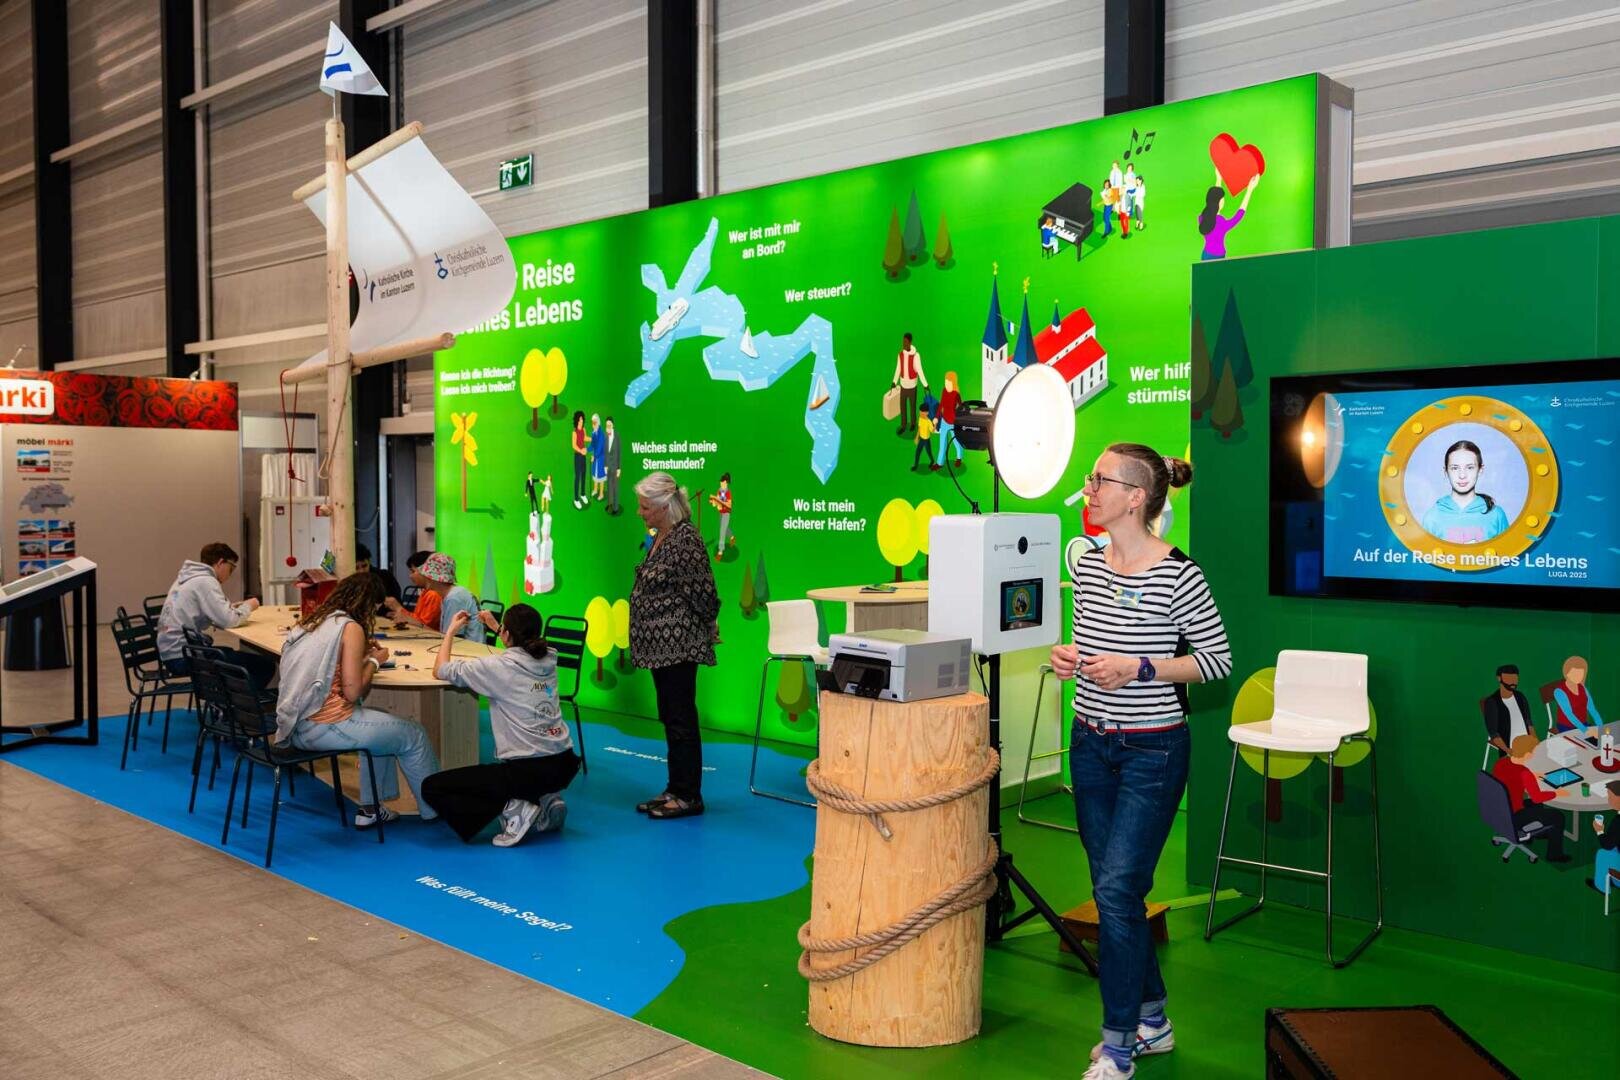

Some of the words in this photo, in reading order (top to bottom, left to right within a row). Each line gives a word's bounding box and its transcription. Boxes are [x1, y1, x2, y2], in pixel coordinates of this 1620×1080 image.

[728, 229, 747, 244] Wer
[749, 226, 762, 240] ist
[764, 223, 781, 237] mit
[783, 219, 801, 234] mir
[742, 250, 754, 259] an
[757, 240, 786, 257] Bord?
[522, 259, 575, 290] Reise
[784, 289, 805, 303] Wer
[807, 281, 852, 300] steuert?
[515, 297, 583, 328] Lebens
[460, 369, 471, 380] ich
[1129, 366, 1160, 381] Wer
[460, 384, 471, 394] ich
[471, 382, 487, 394] mich
[631, 441, 667, 454] Welches
[669, 440, 687, 453] sind
[689, 440, 718, 453] meine
[642, 457, 706, 470] Sternstunden?
[793, 498, 810, 512] Wo
[812, 498, 826, 512] ist
[828, 499, 855, 512] mein
[783, 516, 825, 530] sicherer
[827, 517, 867, 531] Hafen?
[1353, 548, 1379, 563] Auf
[1383, 549, 1408, 564] der
[1412, 550, 1456, 565] Reise
[1459, 551, 1520, 568] meines
[1525, 552, 1588, 569] Lebens
[1569, 571, 1587, 579] 2025
[416, 875, 446, 889] Was
[442, 885, 477, 899] füllt
[470, 896, 518, 915] meine
[515, 911, 573, 932] Segel?
